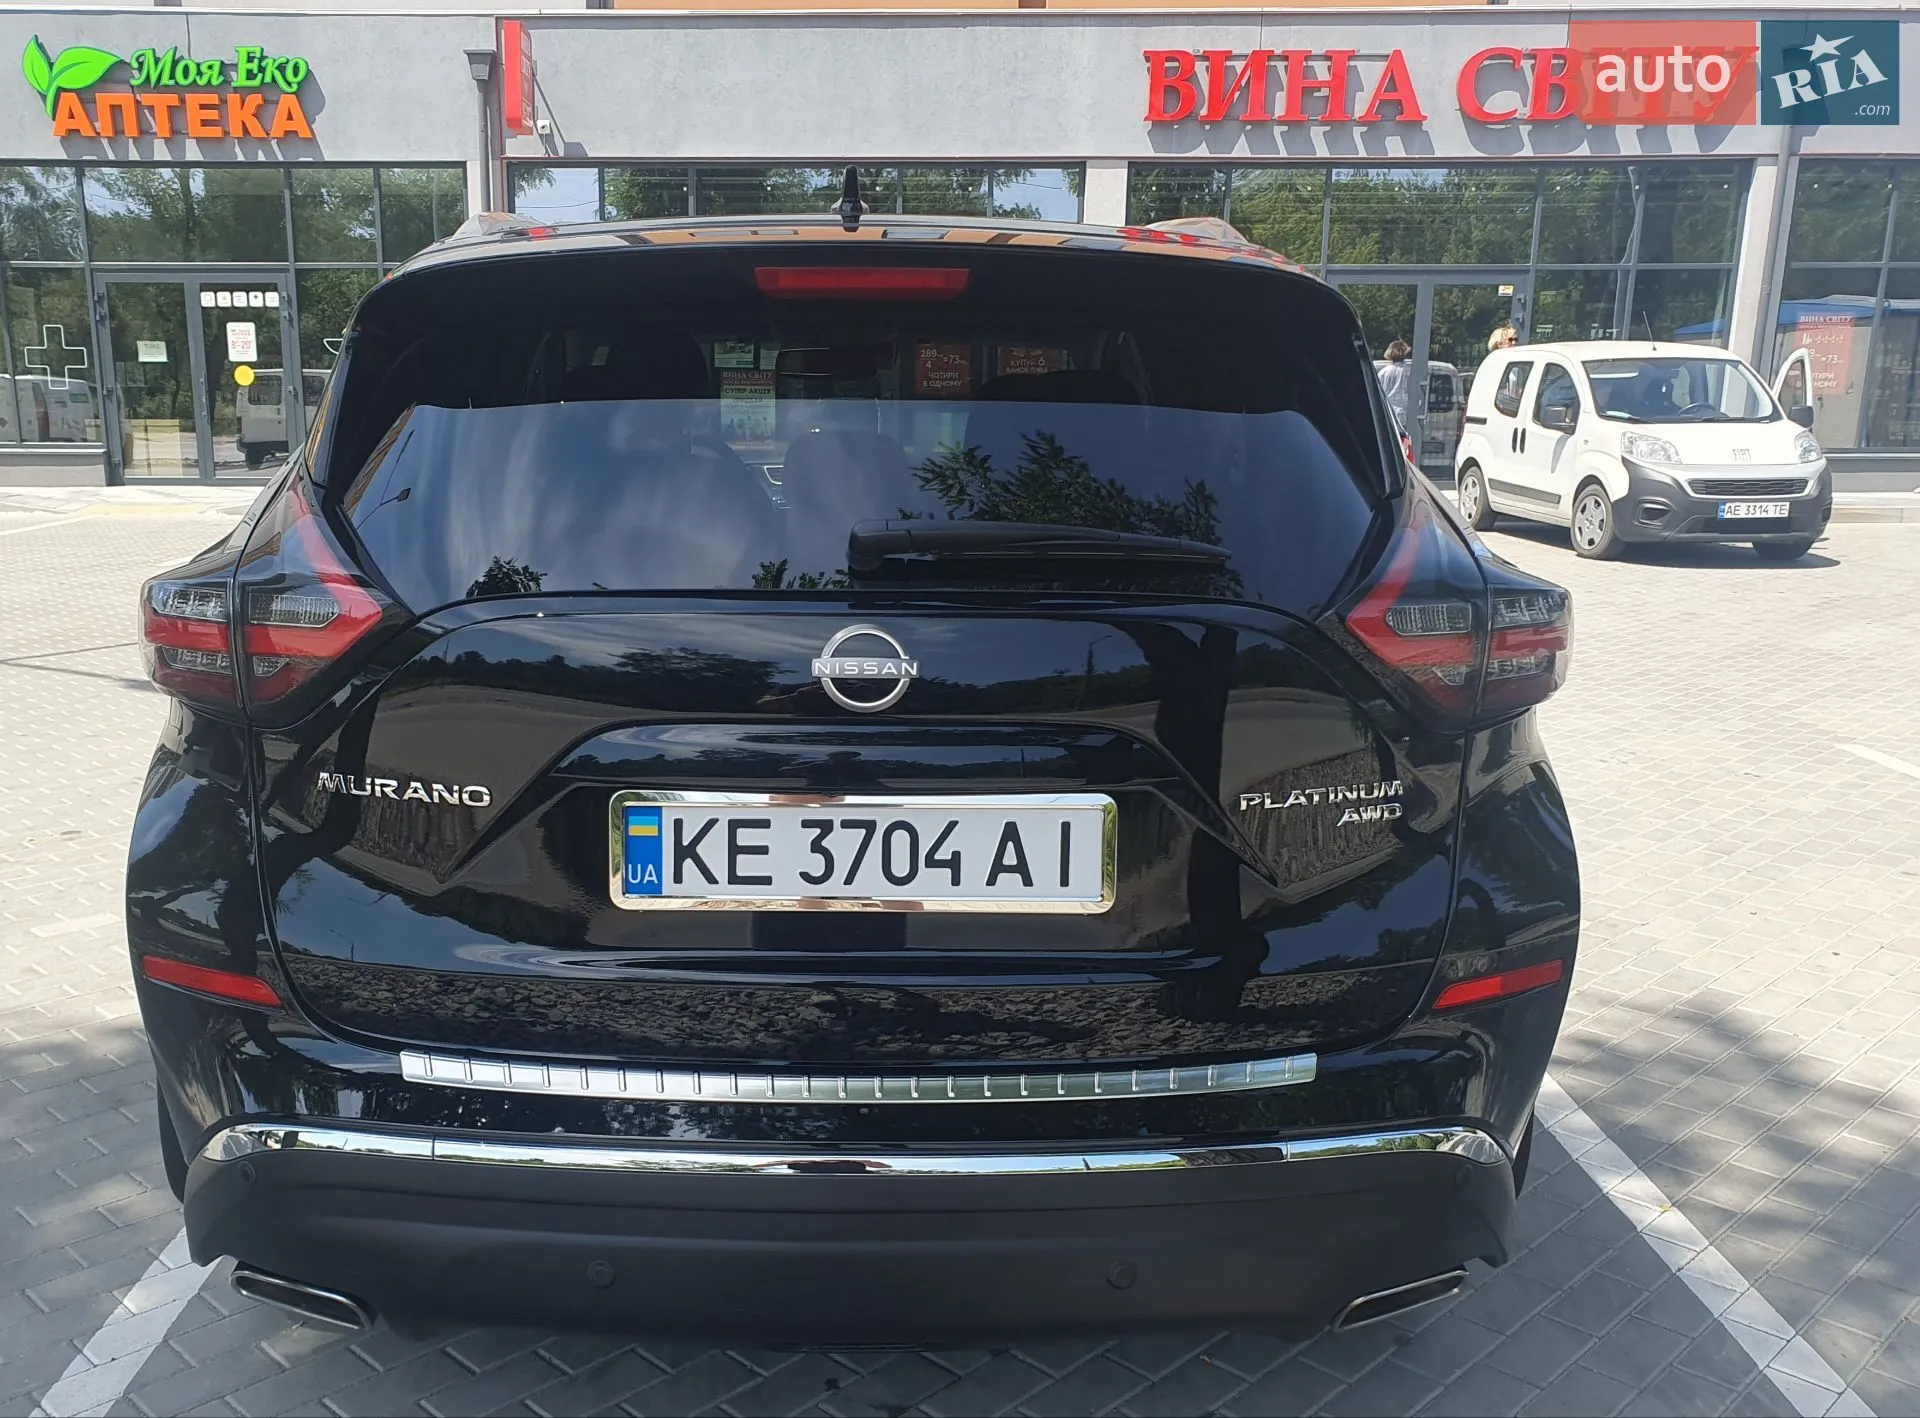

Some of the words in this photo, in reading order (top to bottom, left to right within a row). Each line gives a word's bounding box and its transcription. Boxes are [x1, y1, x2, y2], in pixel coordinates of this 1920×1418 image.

[129, 46, 224, 88] Моя
[231, 45, 309, 93] Еко
[1142, 48, 1429, 123] ВИНА
[52, 92, 313, 139] АПТЕКА
[920, 349, 938, 358] 289
[928, 371, 959, 380] ЧОТИРИ
[929, 380, 962, 388] ОДНОМУ
[1725, 505, 1741, 516] AE
[1744, 504, 1770, 516] 3314
[1773, 503, 1788, 515] TE
[815, 662, 917, 675] NISSAN
[317, 772, 492, 807] MURANO
[1239, 780, 1404, 811] PLATINUM
[1337, 803, 1403, 827] AWD
[628, 863, 659, 884] UA
[673, 817, 773, 886] KE
[798, 818, 962, 887] 3704
